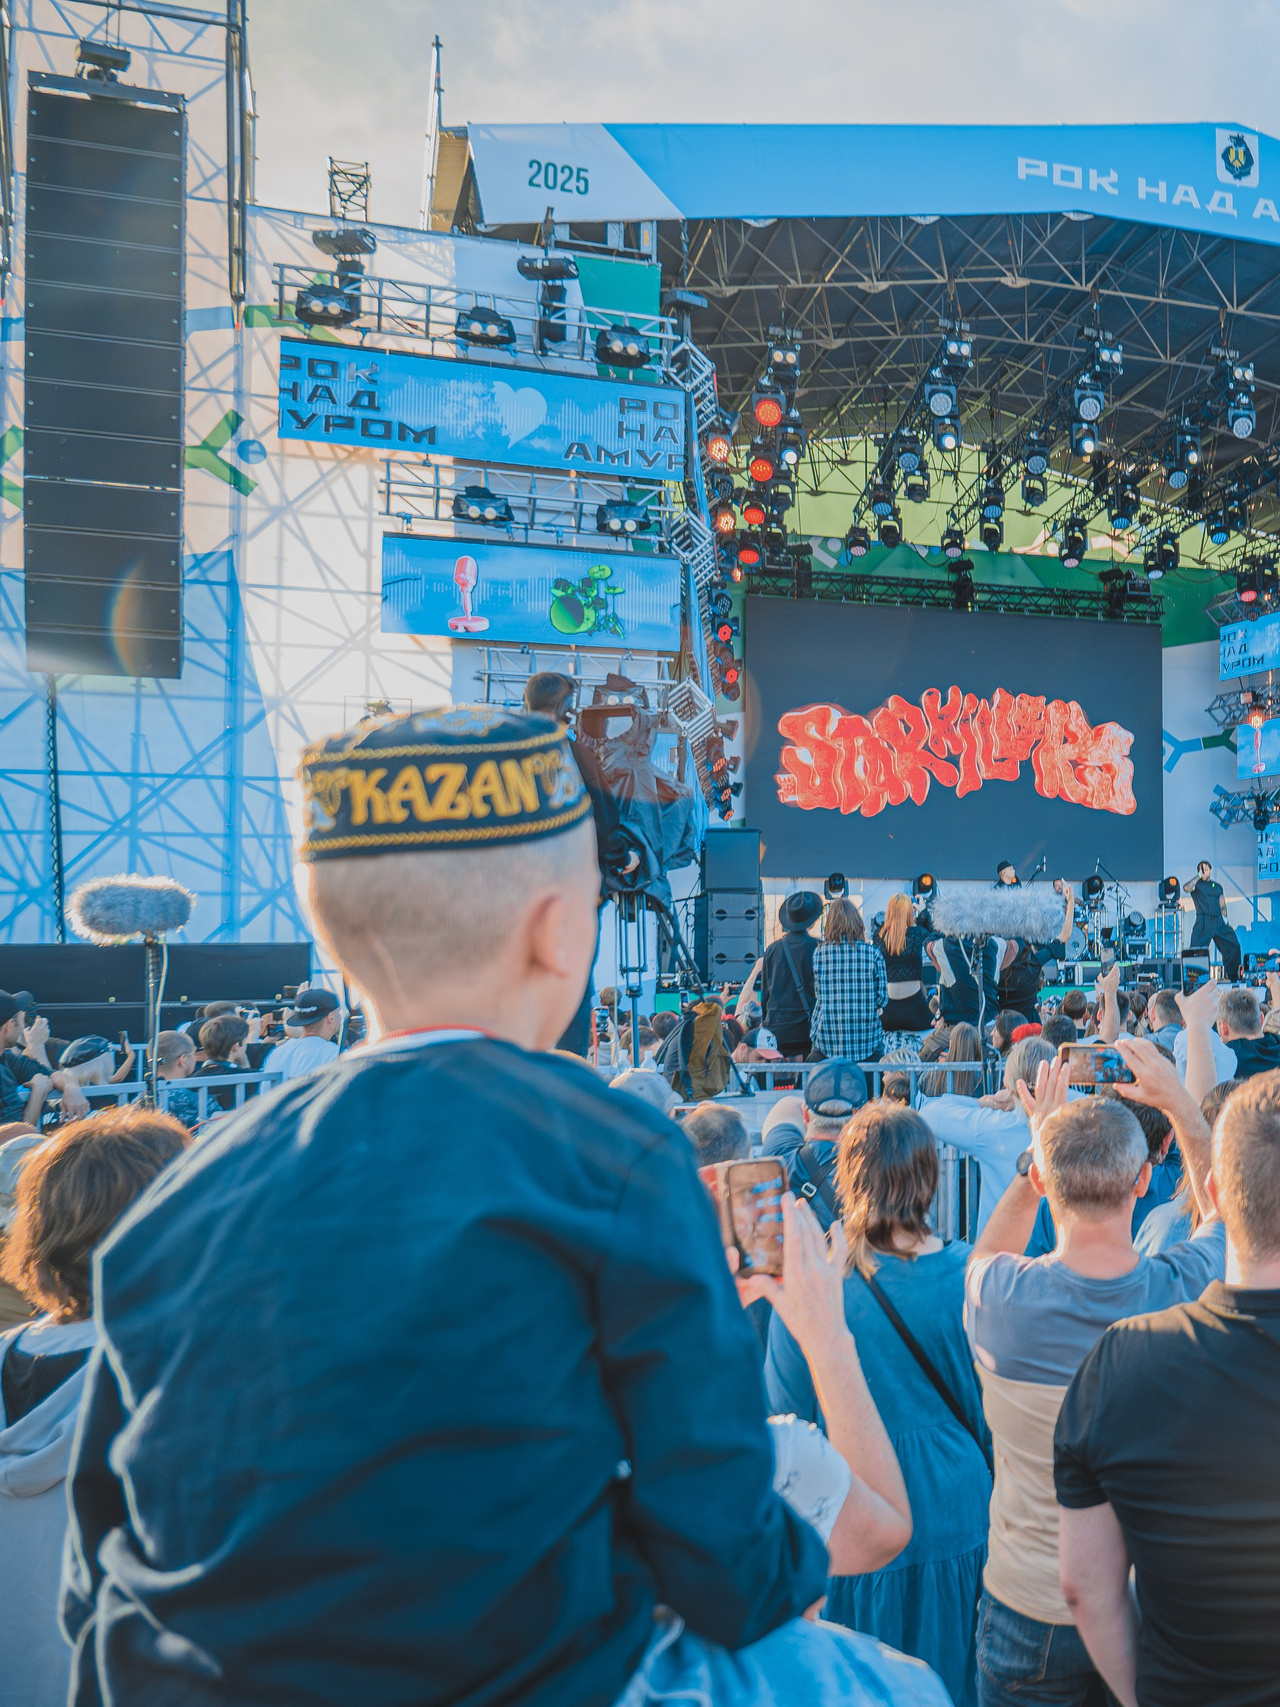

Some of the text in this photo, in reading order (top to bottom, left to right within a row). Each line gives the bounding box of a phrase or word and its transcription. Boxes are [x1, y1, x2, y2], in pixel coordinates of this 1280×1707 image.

[528, 159, 589, 195] 2025
[1017, 157, 1118, 195] РОК
[1138, 177, 1237, 219] НАД
[278, 408, 437, 445] УРОМ
[1220, 654, 1264, 674] УРОМ
[350, 758, 540, 826] KAZAN
